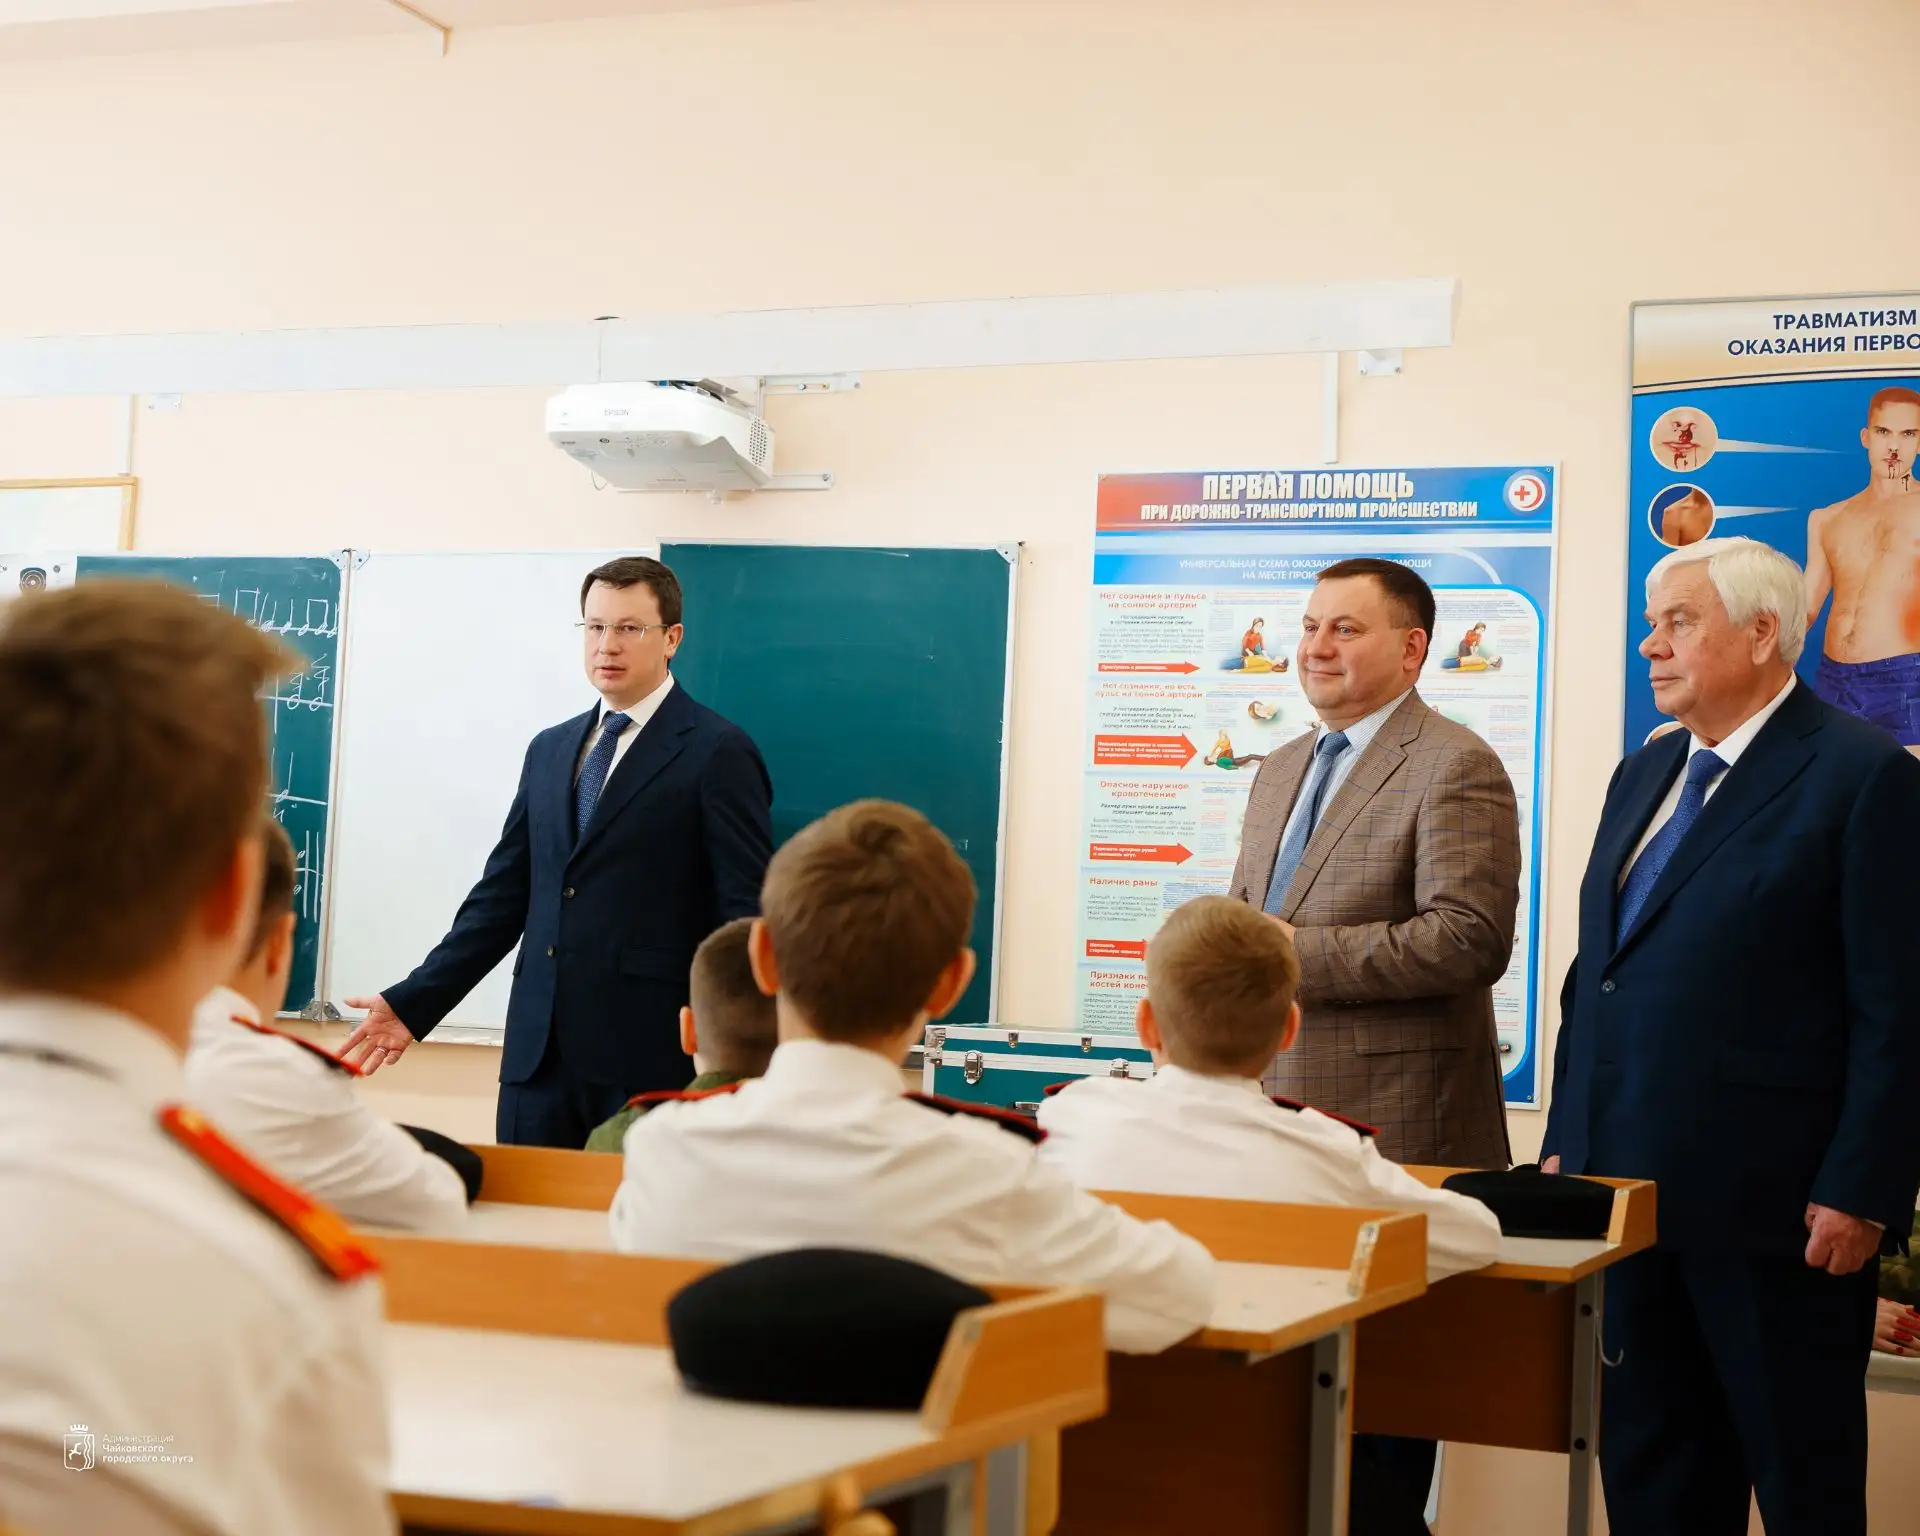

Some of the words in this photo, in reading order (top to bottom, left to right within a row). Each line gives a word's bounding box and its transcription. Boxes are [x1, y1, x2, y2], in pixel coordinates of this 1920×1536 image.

[1772, 309, 1917, 331] ТРАВМАТИЗМ
[1727, 336, 1846, 356] ОКАЗАНИЯ
[604, 408, 631, 417] EPSON
[1202, 473, 1294, 501] ПЕРВАЯ
[1299, 472, 1415, 502] ПОМОЩЬ
[1140, 503, 1169, 521] ПРИ
[1171, 502, 1357, 523] ДОРОЖНО-ТРАНСПОРТНОМ
[1359, 501, 1479, 518] ПРОИСШЕСТВИИ
[1179, 559, 1256, 569] УНИВЕРСАЛЬНАЯ
[1258, 559, 1289, 569] СХЕМА
[1242, 571, 1256, 580] НА
[1258, 571, 1287, 580] МЕСТЕ
[1100, 592, 1116, 600] Нет
[1174, 593, 1207, 602] пульса
[1122, 601, 1156, 609] сонной
[1158, 602, 1197, 610] артерии
[1095, 691, 1120, 699] пульс
[1167, 692, 1203, 700] артерии
[1100, 781, 1140, 789] Опасное
[1142, 782, 1190, 792] наружное
[1111, 791, 1177, 799] кровотечение
[1089, 877, 1130, 886] Наличие
[1132, 879, 1158, 887] раны
[1090, 971, 1136, 980] Признаки
